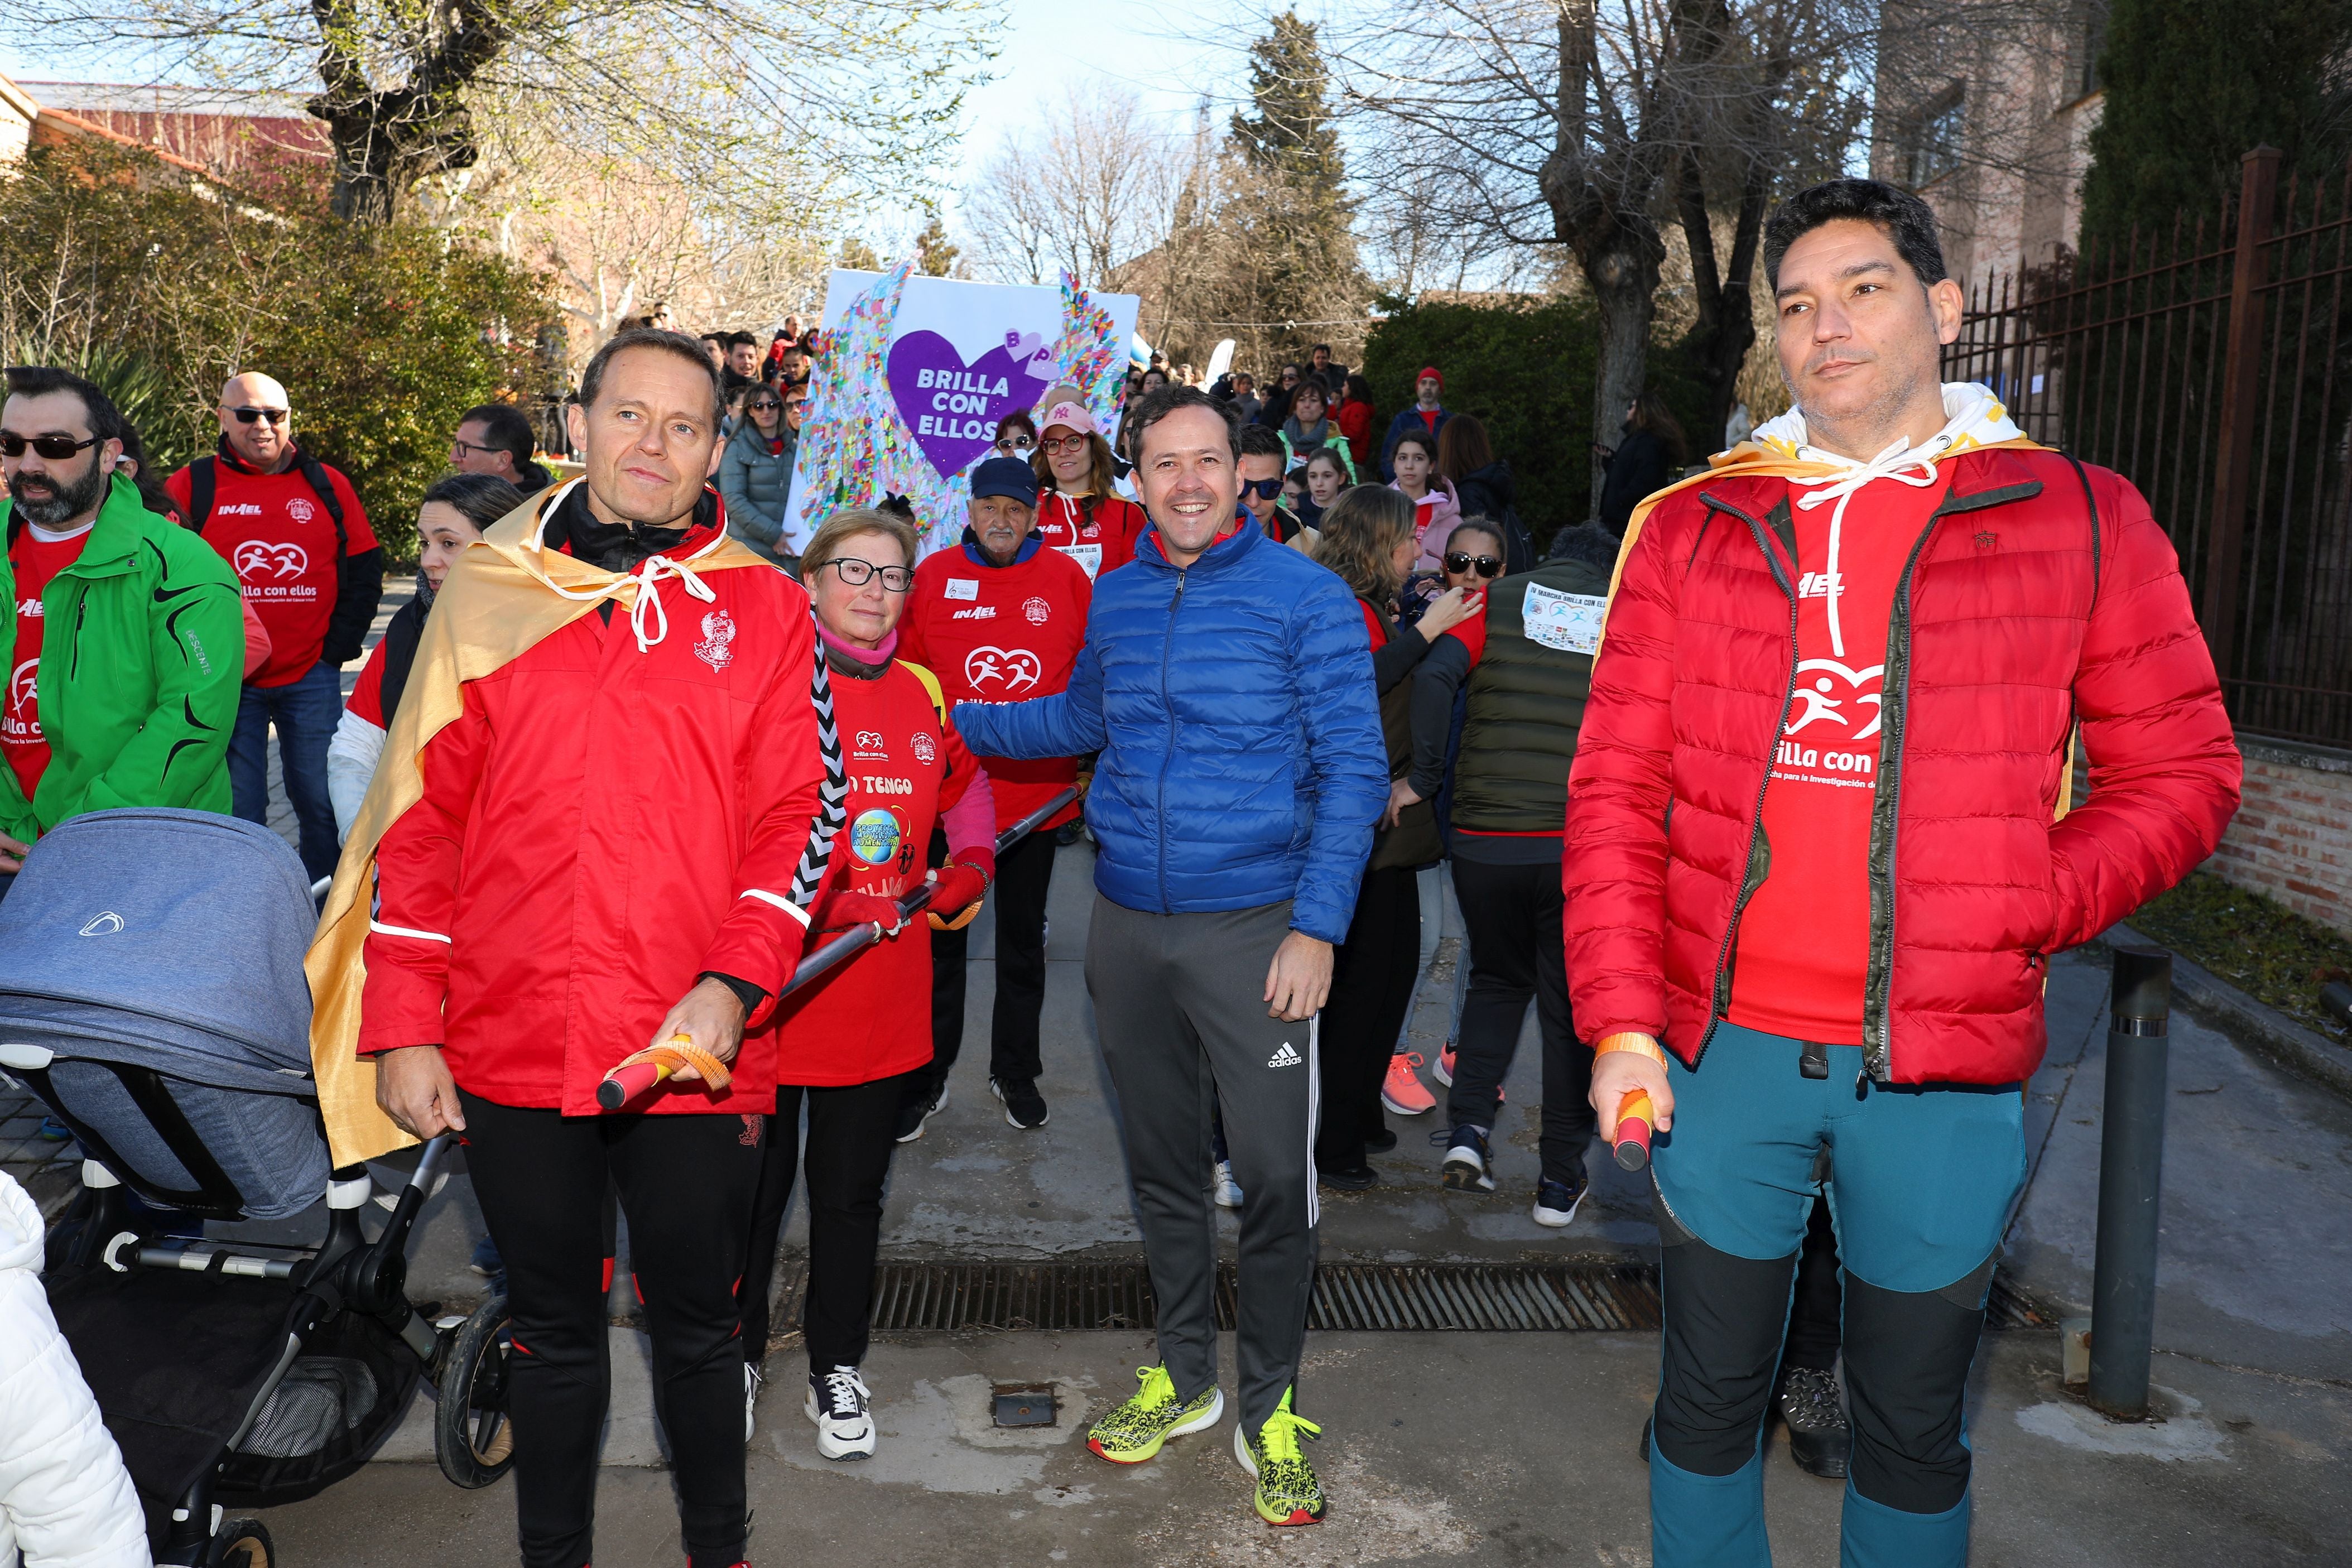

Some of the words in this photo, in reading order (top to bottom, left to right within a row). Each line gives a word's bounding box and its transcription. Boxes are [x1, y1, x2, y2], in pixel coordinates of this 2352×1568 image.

[1006, 332, 1019, 348] B
[1033, 348, 1050, 361] P
[917, 368, 1008, 397] BRILLA
[932, 392, 988, 415] CON
[918, 415, 998, 441] ELLOS
[218, 503, 262, 515] INAEL
[1036, 525, 1062, 533] NAEL
[264, 587, 287, 595] con
[290, 585, 316, 595] ellos
[1798, 571, 1845, 598] AEL
[1537, 589, 1561, 600] MARCHA
[1563, 595, 1582, 604] BRILLA
[953, 606, 996, 619] INAEL
[186, 629, 211, 675] DESCENTE
[1776, 740, 1817, 767] illa
[1823, 751, 1871, 773] con
[863, 776, 912, 795] TENGO
[1810, 775, 1865, 787] Investigación
[856, 824, 896, 832] PROYECTO
[1268, 1056, 1302, 1067] adidas
